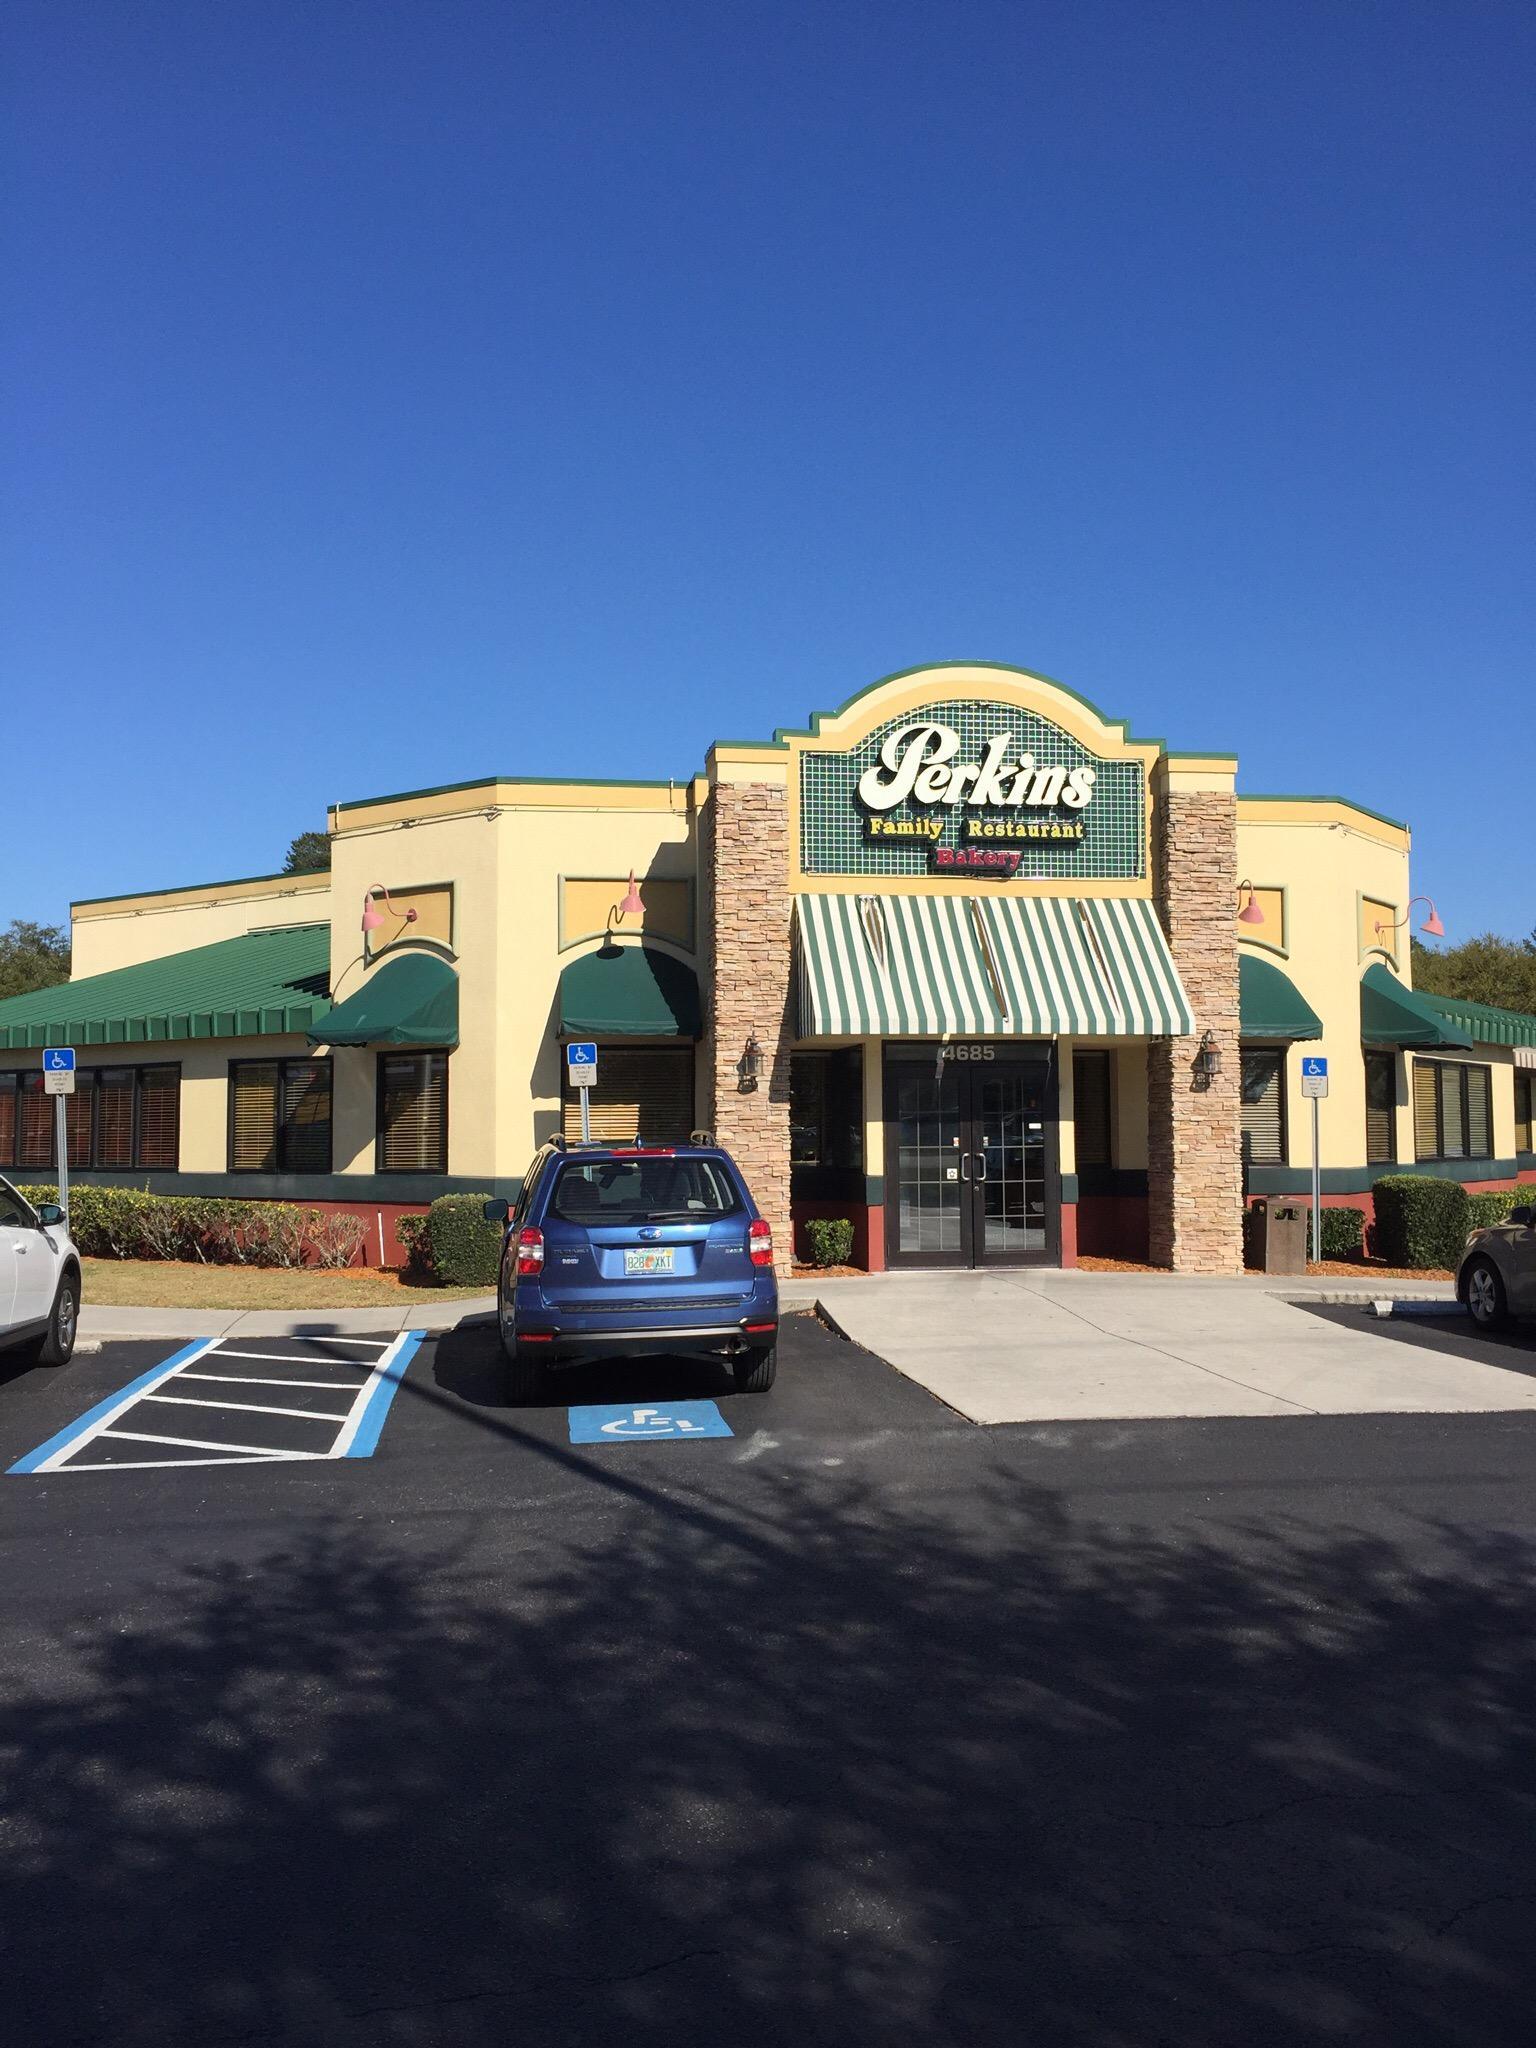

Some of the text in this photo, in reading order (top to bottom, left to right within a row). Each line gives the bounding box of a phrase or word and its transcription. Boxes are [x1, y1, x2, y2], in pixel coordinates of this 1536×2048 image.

[859, 722, 1096, 809] Perkins
[870, 817, 1083, 839] Family Restaurant
[936, 848, 1022, 870] Bakery
[943, 1045, 995, 1061] 4685
